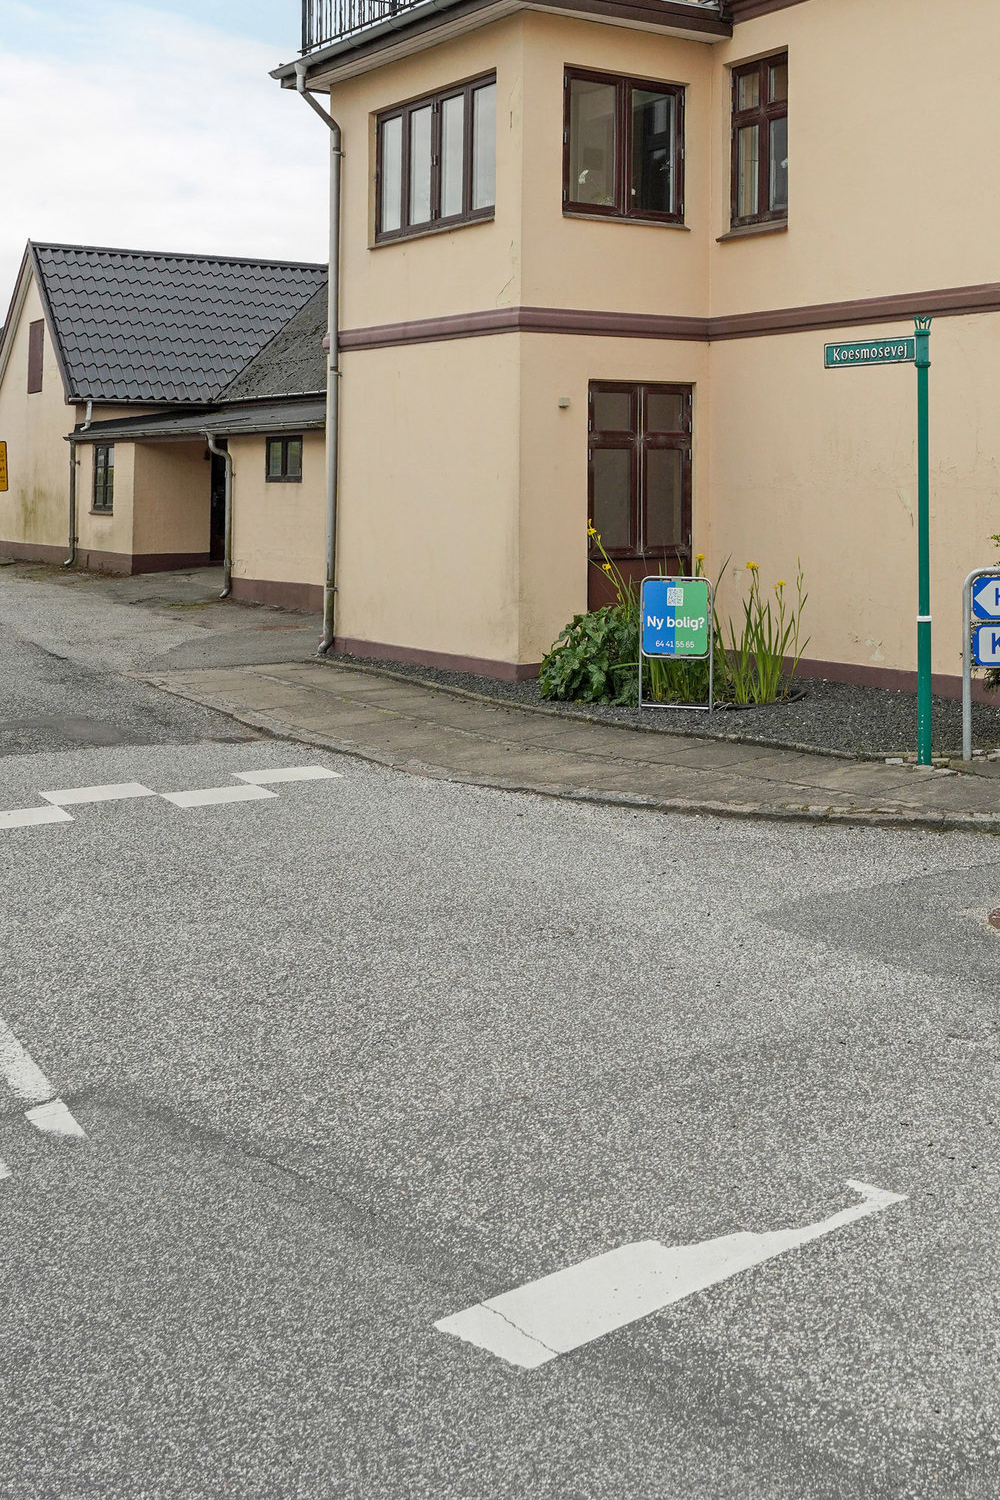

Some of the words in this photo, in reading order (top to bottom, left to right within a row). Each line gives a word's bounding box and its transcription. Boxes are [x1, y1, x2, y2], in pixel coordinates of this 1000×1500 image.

[833, 343, 907, 361] Koesmosevej
[647, 615, 664, 630] Ny
[666, 616, 705, 631] bolig?
[655, 640, 665, 648] 64
